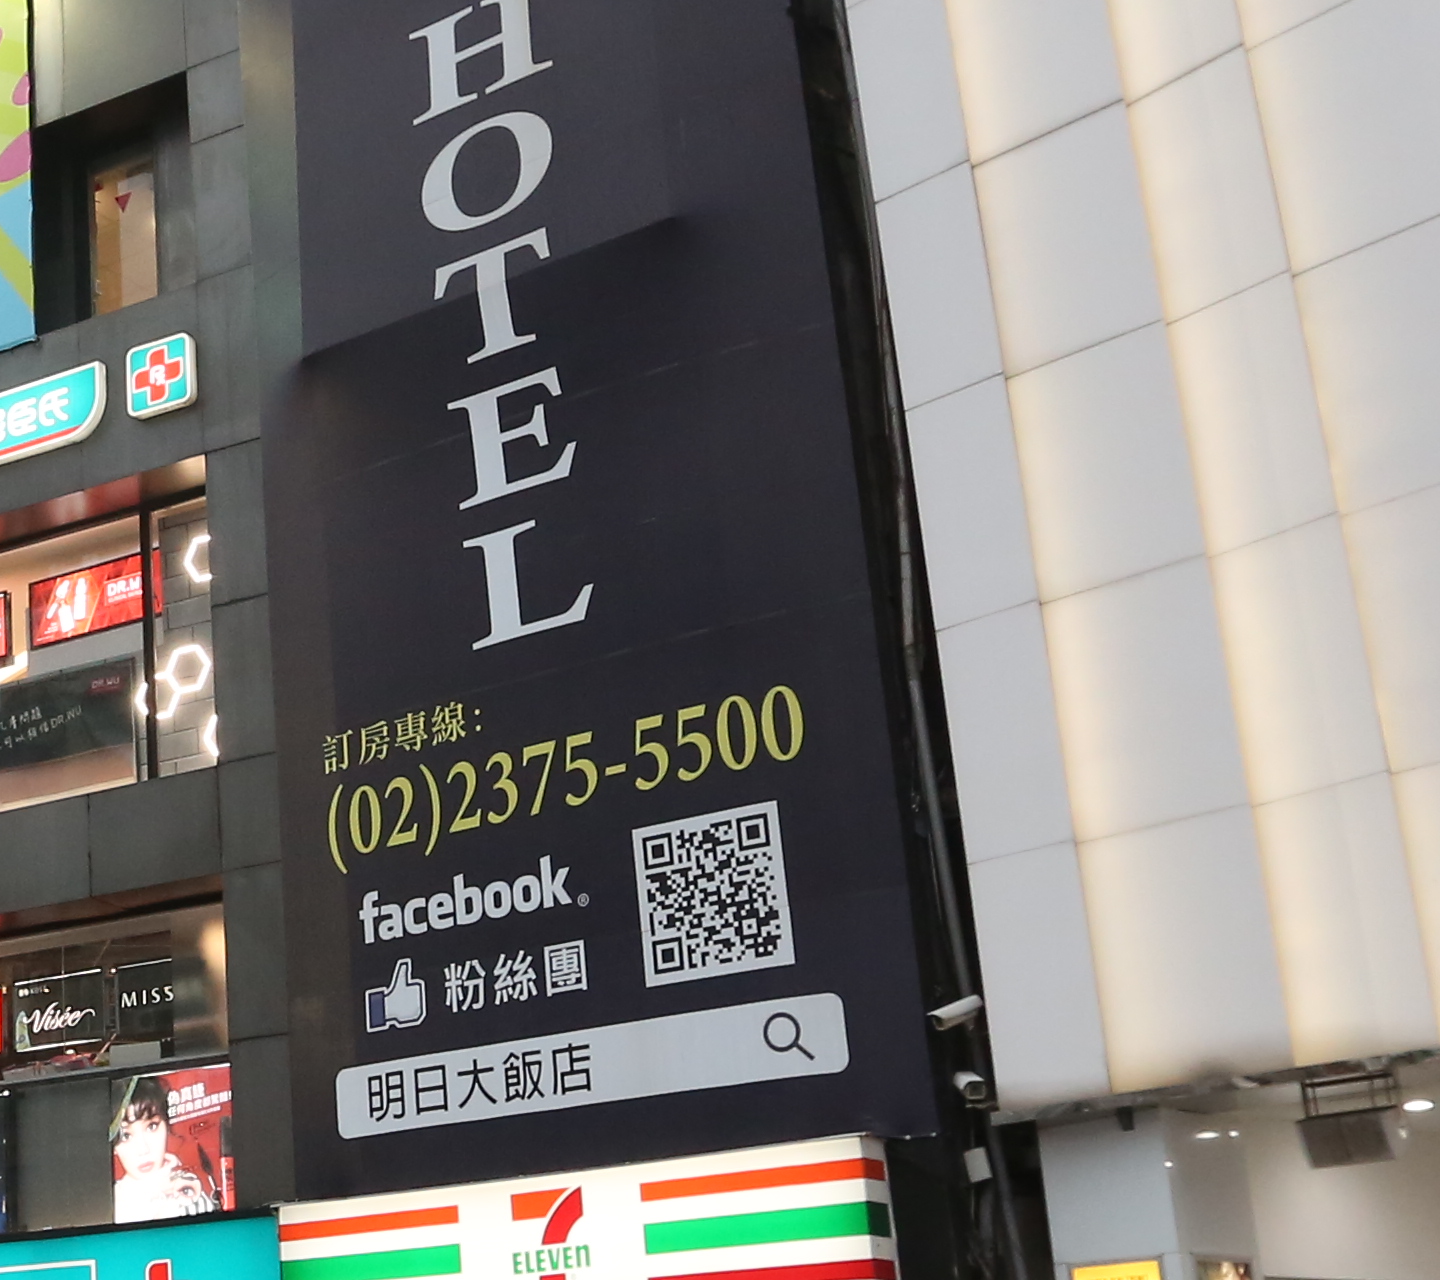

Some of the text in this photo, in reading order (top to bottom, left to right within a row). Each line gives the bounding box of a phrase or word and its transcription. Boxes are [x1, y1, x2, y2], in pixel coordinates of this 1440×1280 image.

[327, 683, 805, 874] (02)2375-5500
[359, 854, 574, 945] facebook
[120, 984, 175, 1010] MISS
[443, 939, 590, 1014] 粉絲團
[367, 1041, 594, 1124] 明日大飯店
